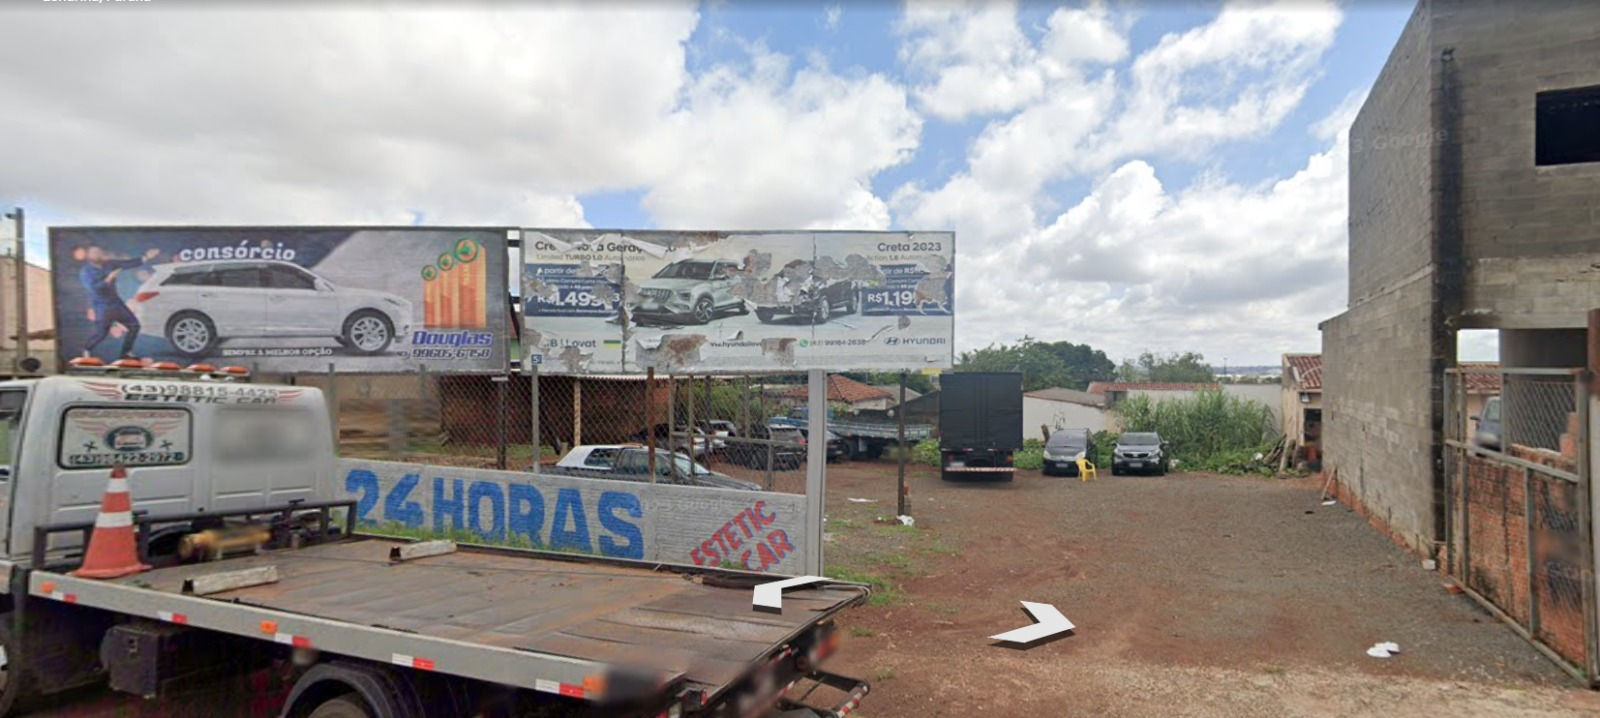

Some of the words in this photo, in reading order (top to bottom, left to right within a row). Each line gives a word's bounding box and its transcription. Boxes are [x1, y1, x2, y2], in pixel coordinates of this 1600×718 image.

[179, 239, 296, 261] consórcio
[878, 242, 910, 252] Creta
[912, 242, 942, 252] 2023
[411, 330, 494, 347] Douglas
[902, 337, 946, 345] HYUNDAI
[124, 393, 227, 404] ESTETIC
[236, 396, 277, 405] CAR
[345, 468, 425, 529] 24
[432, 476, 645, 560] HORAS
[690, 500, 777, 567] ESTETIC
[741, 529, 796, 573] CAR
